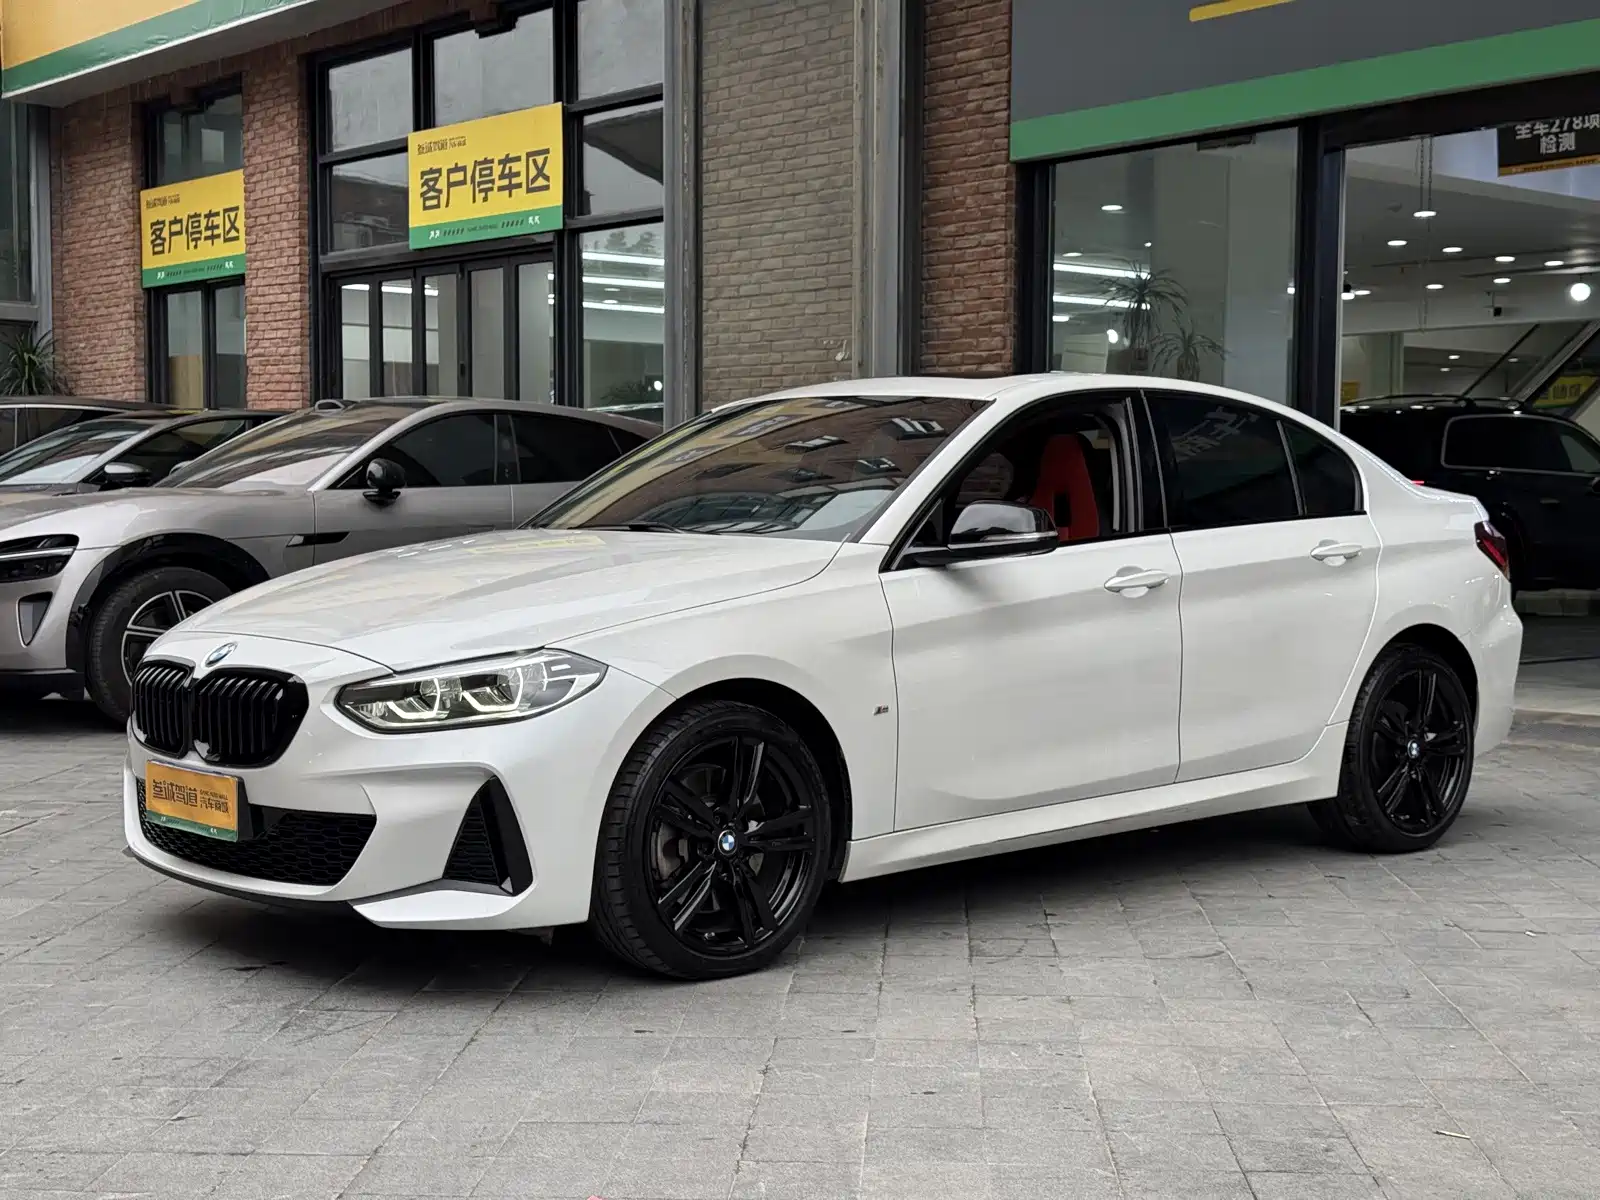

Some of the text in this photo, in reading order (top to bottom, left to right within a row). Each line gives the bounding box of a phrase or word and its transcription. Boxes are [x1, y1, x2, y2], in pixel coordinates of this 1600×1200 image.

[1539, 132, 1576, 155] 检测
[419, 147, 551, 212] 客户停车区
[150, 205, 240, 257] 客户停车区
